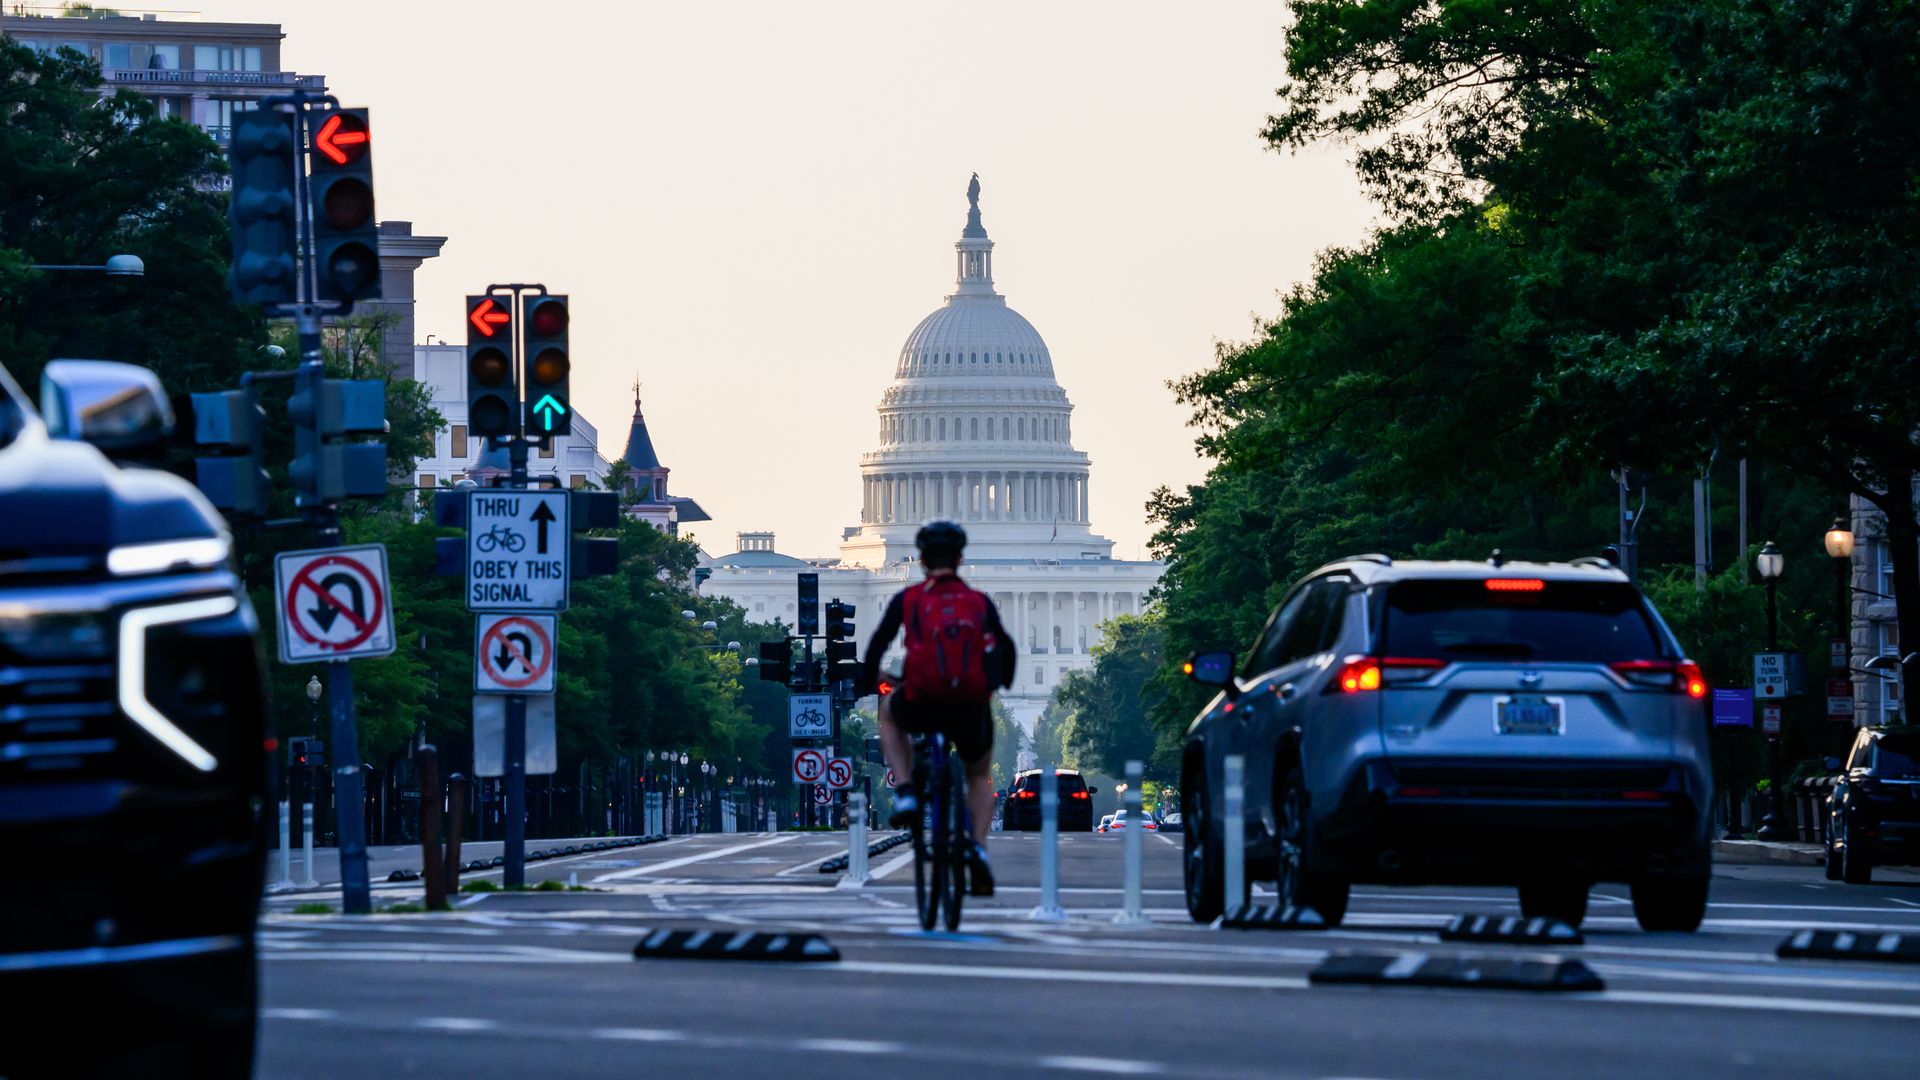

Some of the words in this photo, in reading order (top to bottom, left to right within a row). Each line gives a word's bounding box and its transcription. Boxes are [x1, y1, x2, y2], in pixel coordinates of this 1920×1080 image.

[475, 498, 520, 517] THRU
[473, 560, 518, 579] OBEY
[526, 560, 562, 579] THIS
[473, 583, 533, 602] SIGNAL
[1762, 656, 1776, 665] NO
[1760, 667, 1779, 675] TURN
